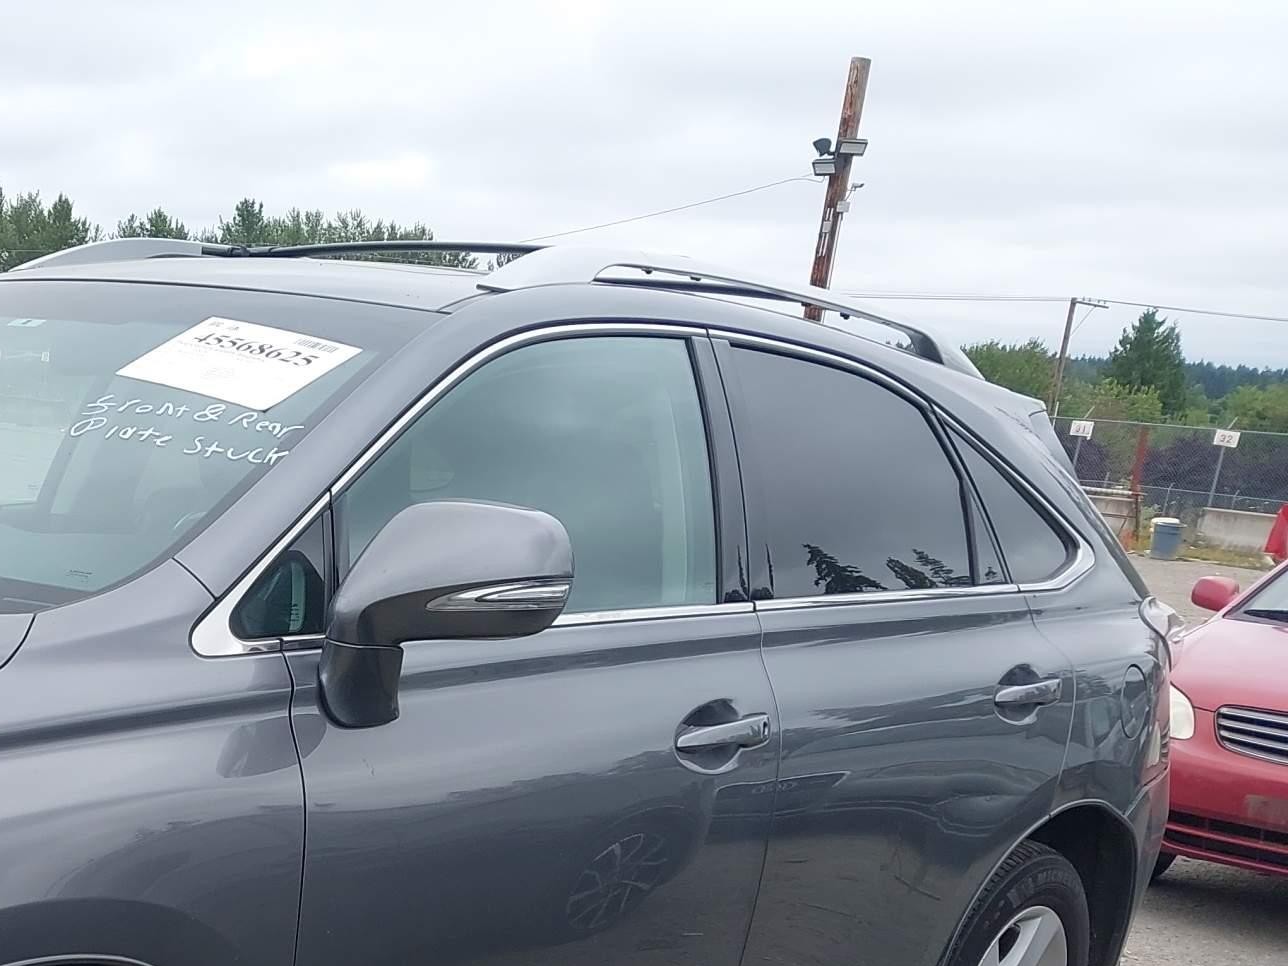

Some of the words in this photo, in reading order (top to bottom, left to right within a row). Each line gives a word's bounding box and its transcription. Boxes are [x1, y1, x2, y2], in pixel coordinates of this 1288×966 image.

[194, 333, 321, 367] 45568625
[70, 416, 173, 446] Plate
[193, 403, 227, 422] &
[228, 411, 305, 438] Rear
